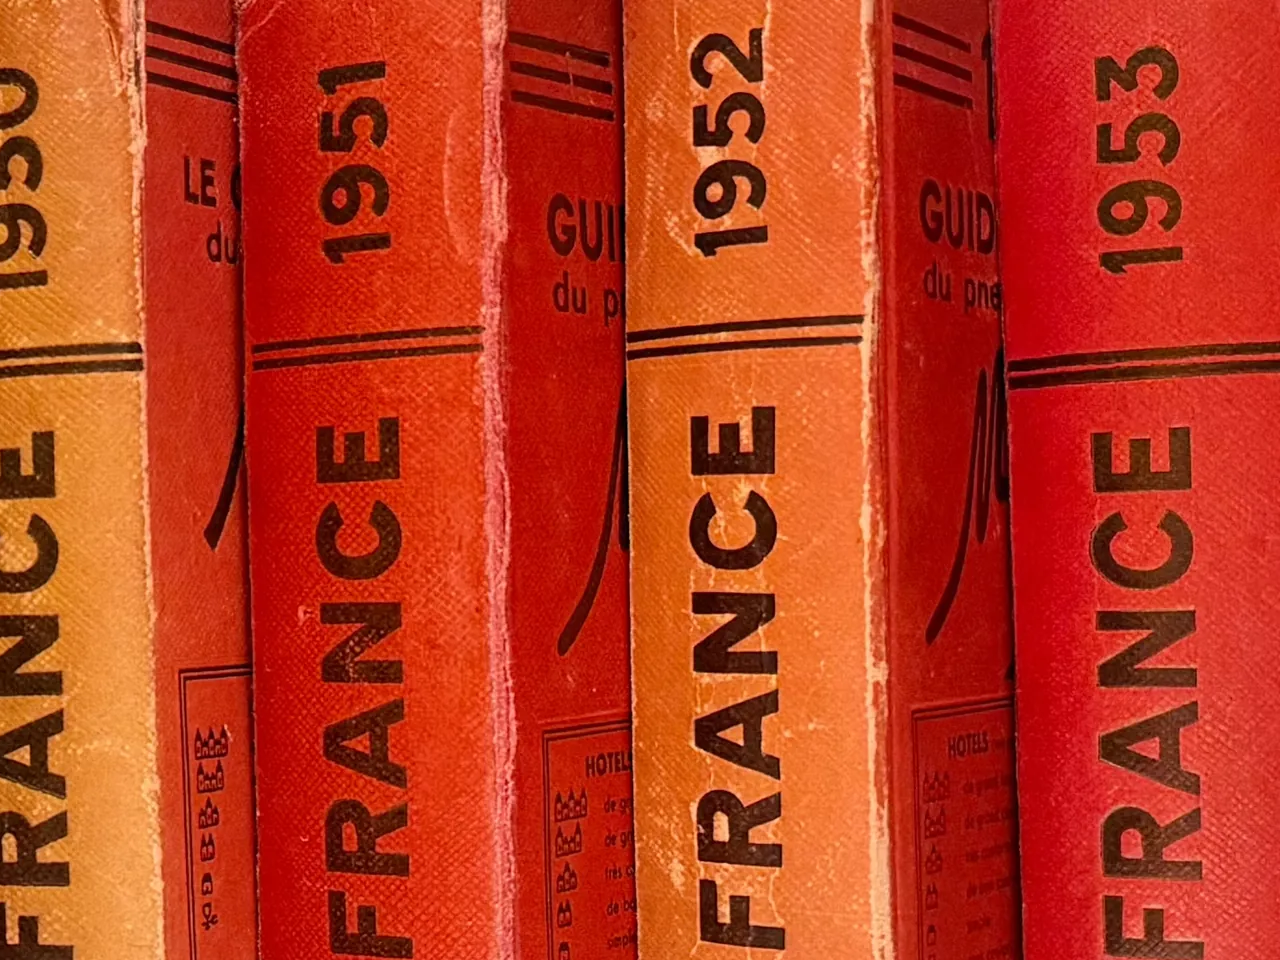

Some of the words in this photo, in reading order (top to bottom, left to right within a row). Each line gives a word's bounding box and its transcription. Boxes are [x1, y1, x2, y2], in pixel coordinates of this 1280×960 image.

[183, 154, 218, 209] LE
[317, 60, 391, 265] 1951
[546, 192, 625, 263] GUI
[689, 26, 768, 259] 1952
[1094, 45, 1184, 277] 1953
[552, 270, 587, 315] du
[923, 259, 952, 302] du
[314, 416, 415, 960] FRANCE
[688, 405, 786, 951] FRANCE
